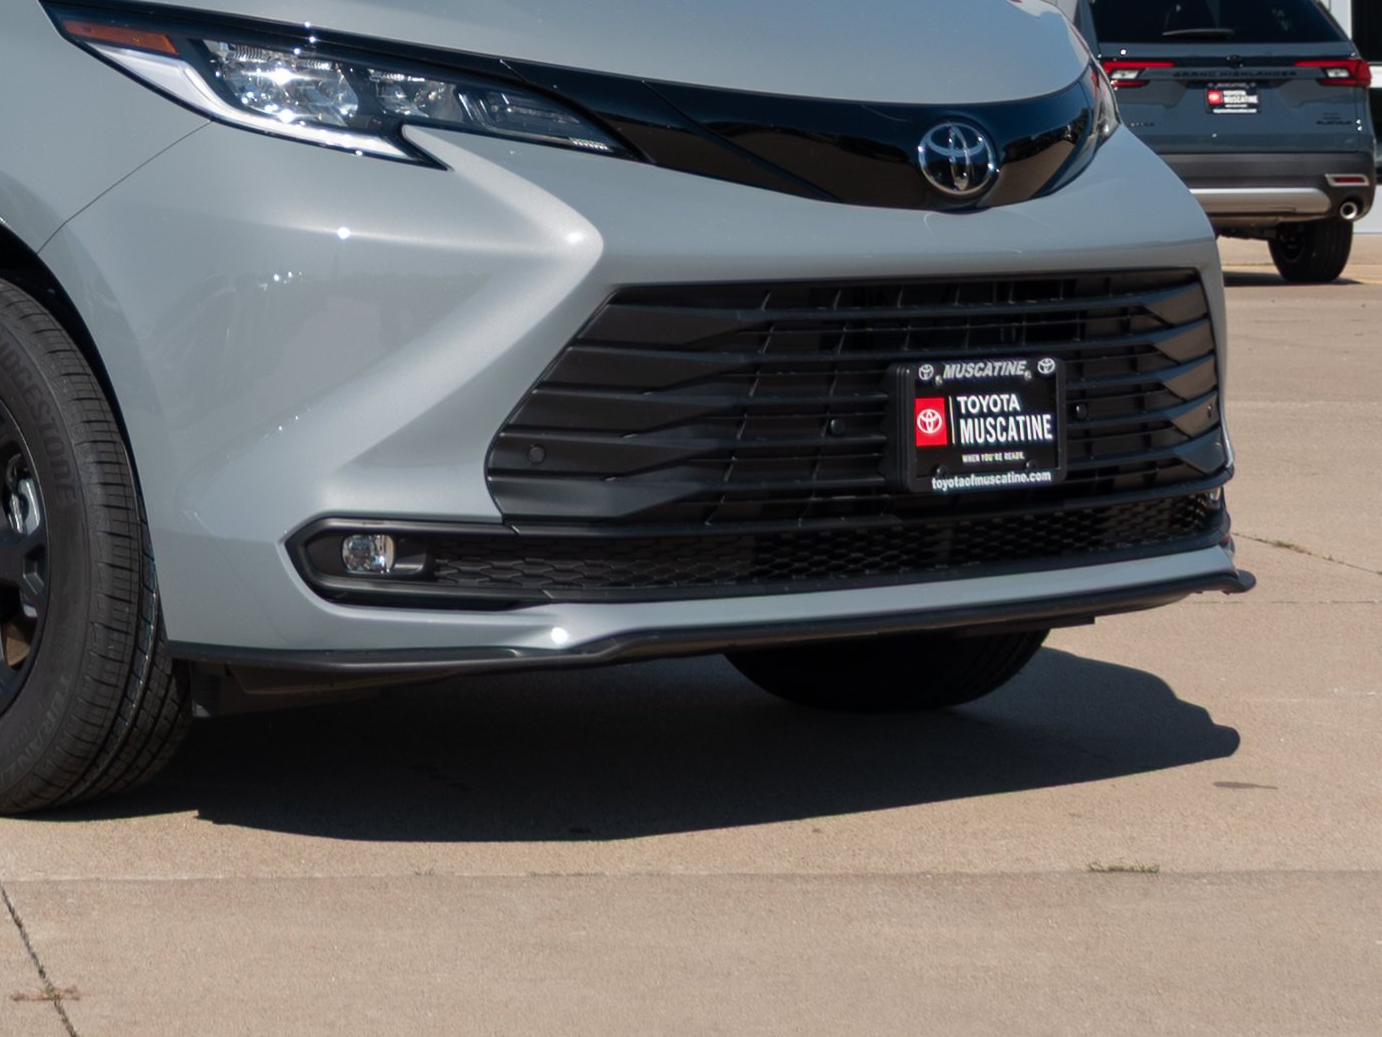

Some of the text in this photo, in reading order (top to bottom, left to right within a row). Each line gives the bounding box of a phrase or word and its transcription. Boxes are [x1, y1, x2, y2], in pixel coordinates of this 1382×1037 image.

[943, 362, 1026, 379] MUSCATINE
[957, 394, 1020, 413] TOYOTA
[960, 415, 1052, 444] MUSCATINE
[932, 471, 1051, 491] toyotaofmuscatine.com
